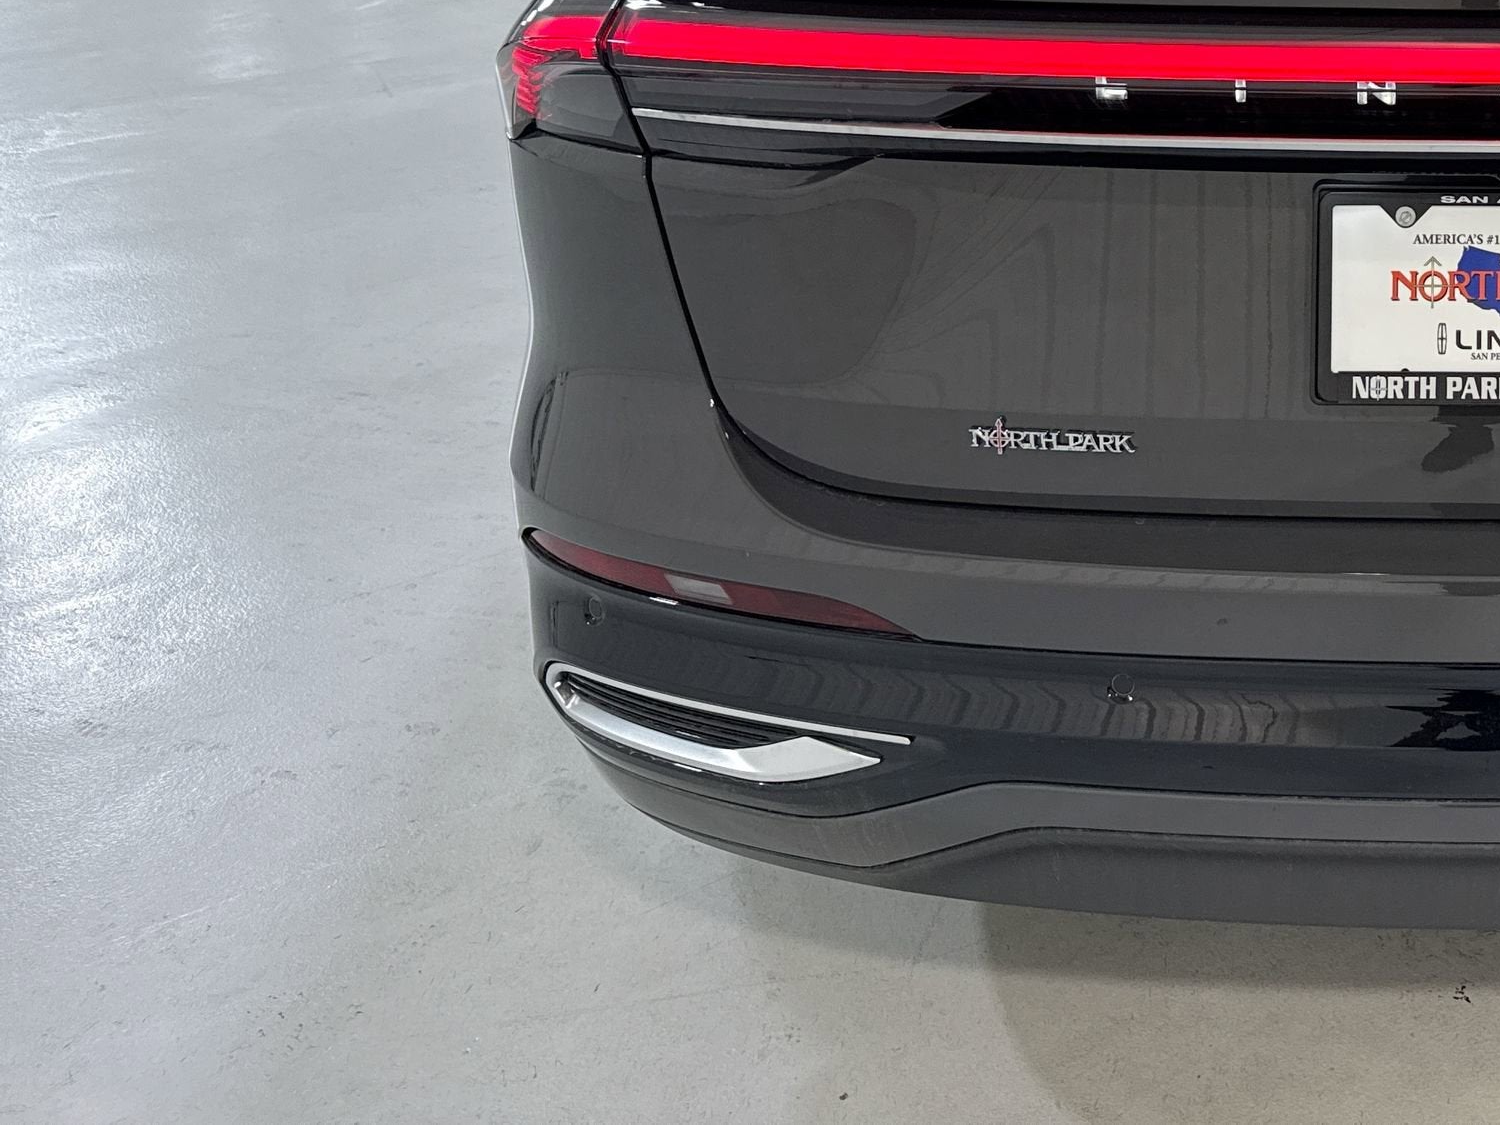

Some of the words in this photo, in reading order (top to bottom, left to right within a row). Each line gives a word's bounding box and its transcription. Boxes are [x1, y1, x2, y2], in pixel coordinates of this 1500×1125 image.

[1440, 195, 1489, 204] SAN
[1413, 233, 1484, 246] AMERICA'S
[1486, 234, 1500, 246] #1
[1470, 352, 1488, 361] SAN
[1352, 374, 1437, 400] NORTH
[968, 427, 1060, 451] NORTH
[1064, 432, 1136, 453] PARK
